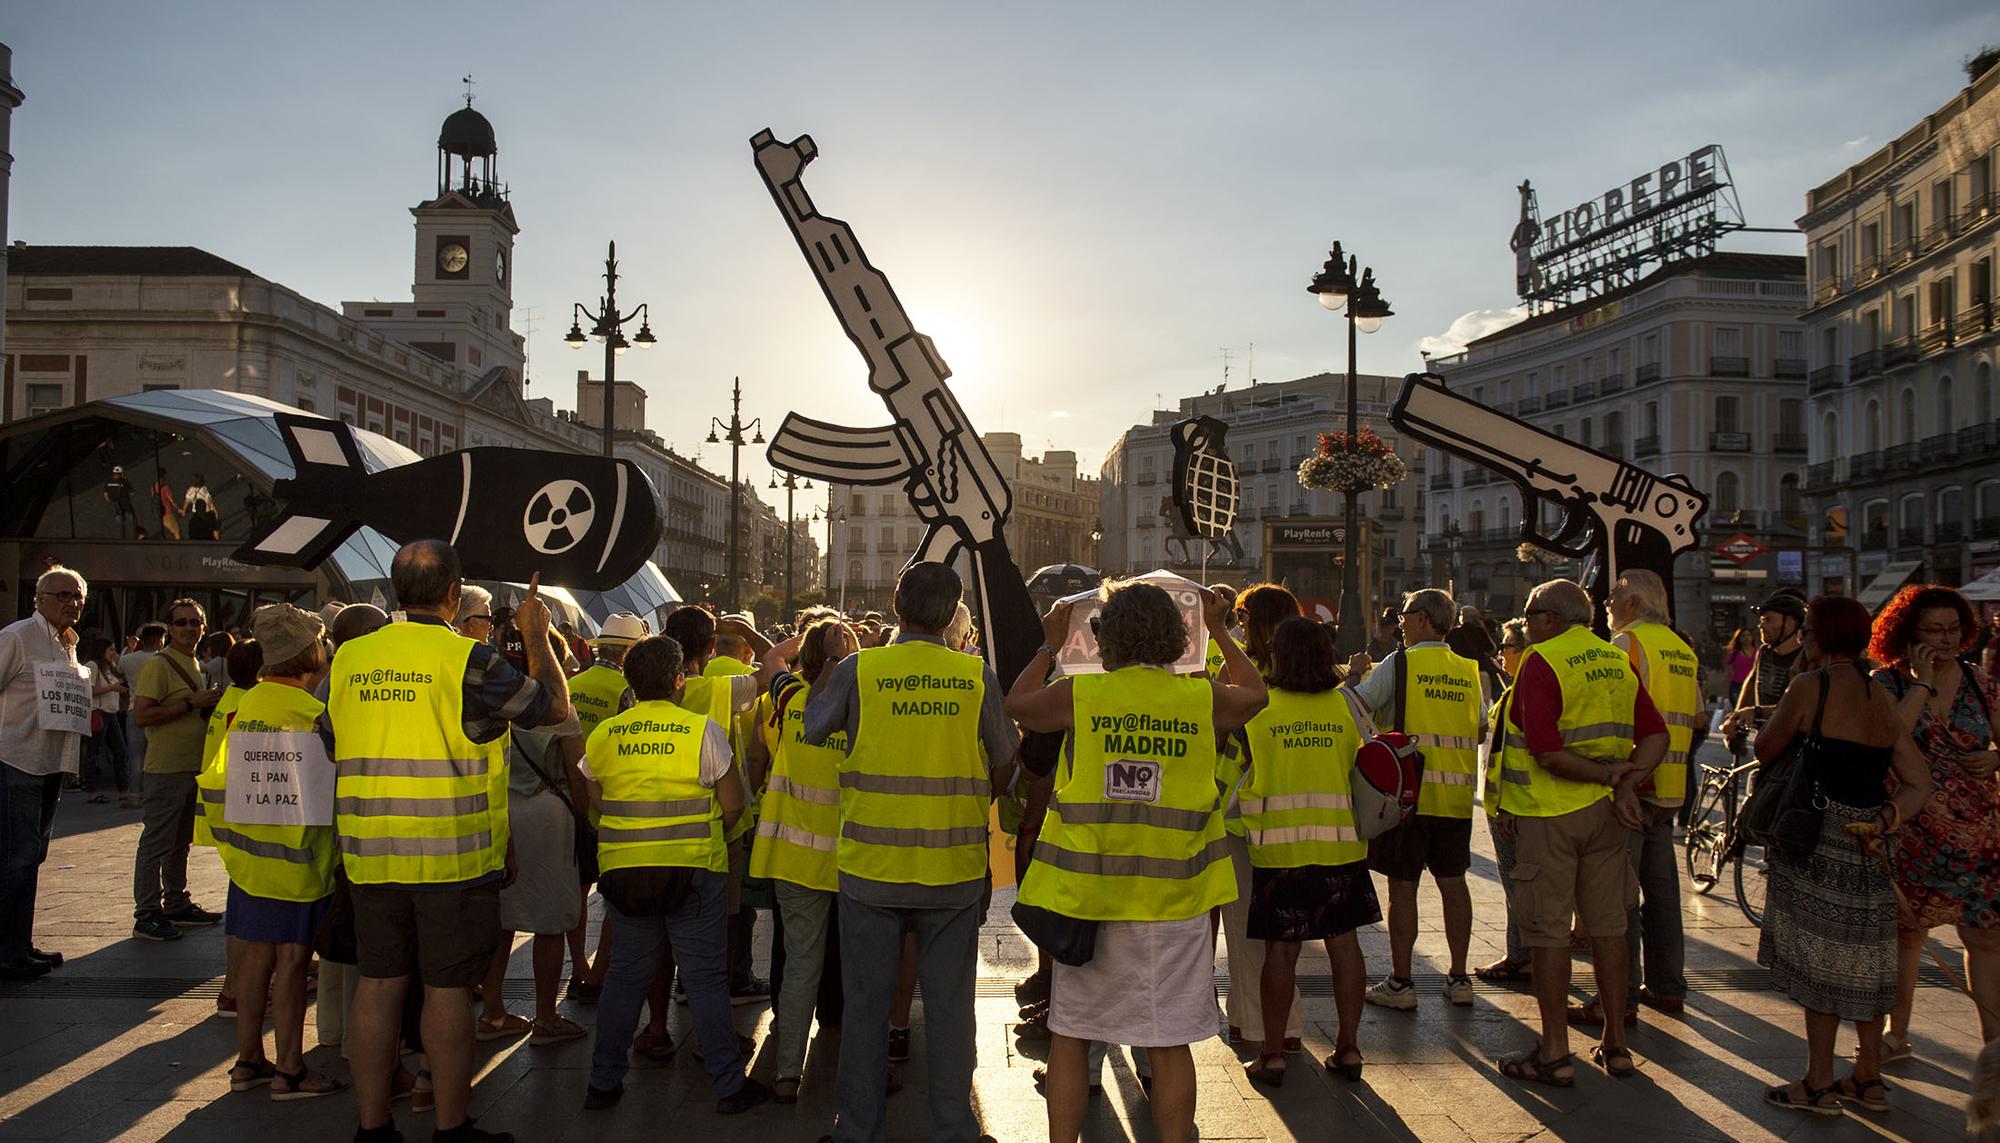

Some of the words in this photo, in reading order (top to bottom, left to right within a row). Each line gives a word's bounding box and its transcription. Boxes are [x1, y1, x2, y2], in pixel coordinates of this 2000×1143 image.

[1544, 202, 1593, 249] TIO
[1604, 145, 1715, 226] PEPE
[1283, 528, 1331, 541] PlayRenfe
[202, 557, 248, 568] PlayRen
[349, 669, 432, 687] yay@flautas
[876, 674, 974, 692] yay@flautas
[1417, 674, 1472, 688] yay@flautas
[42, 690, 62, 701] LOS
[359, 689, 416, 702] MADRID
[570, 692, 609, 708] @flautas
[1425, 688, 1465, 702] MADRID
[50, 703, 63, 713] EL
[892, 702, 960, 716] MADRID
[578, 711, 599, 723] DRID
[1091, 713, 1198, 735] yay@flautas
[608, 721, 690, 737] yay@flautas
[1270, 720, 1343, 737] yay@flautas
[795, 731, 847, 751] MRID
[1104, 734, 1187, 757] MADRID
[1283, 736, 1333, 749] MADRID
[618, 743, 675, 756] MADRID
[244, 751, 303, 763] QUEREMOS
[251, 772, 261, 783] EL
[266, 772, 288, 783] PAN
[246, 794, 251, 804] Y
[256, 794, 270, 805] LA
[275, 794, 299, 805] PAZ
